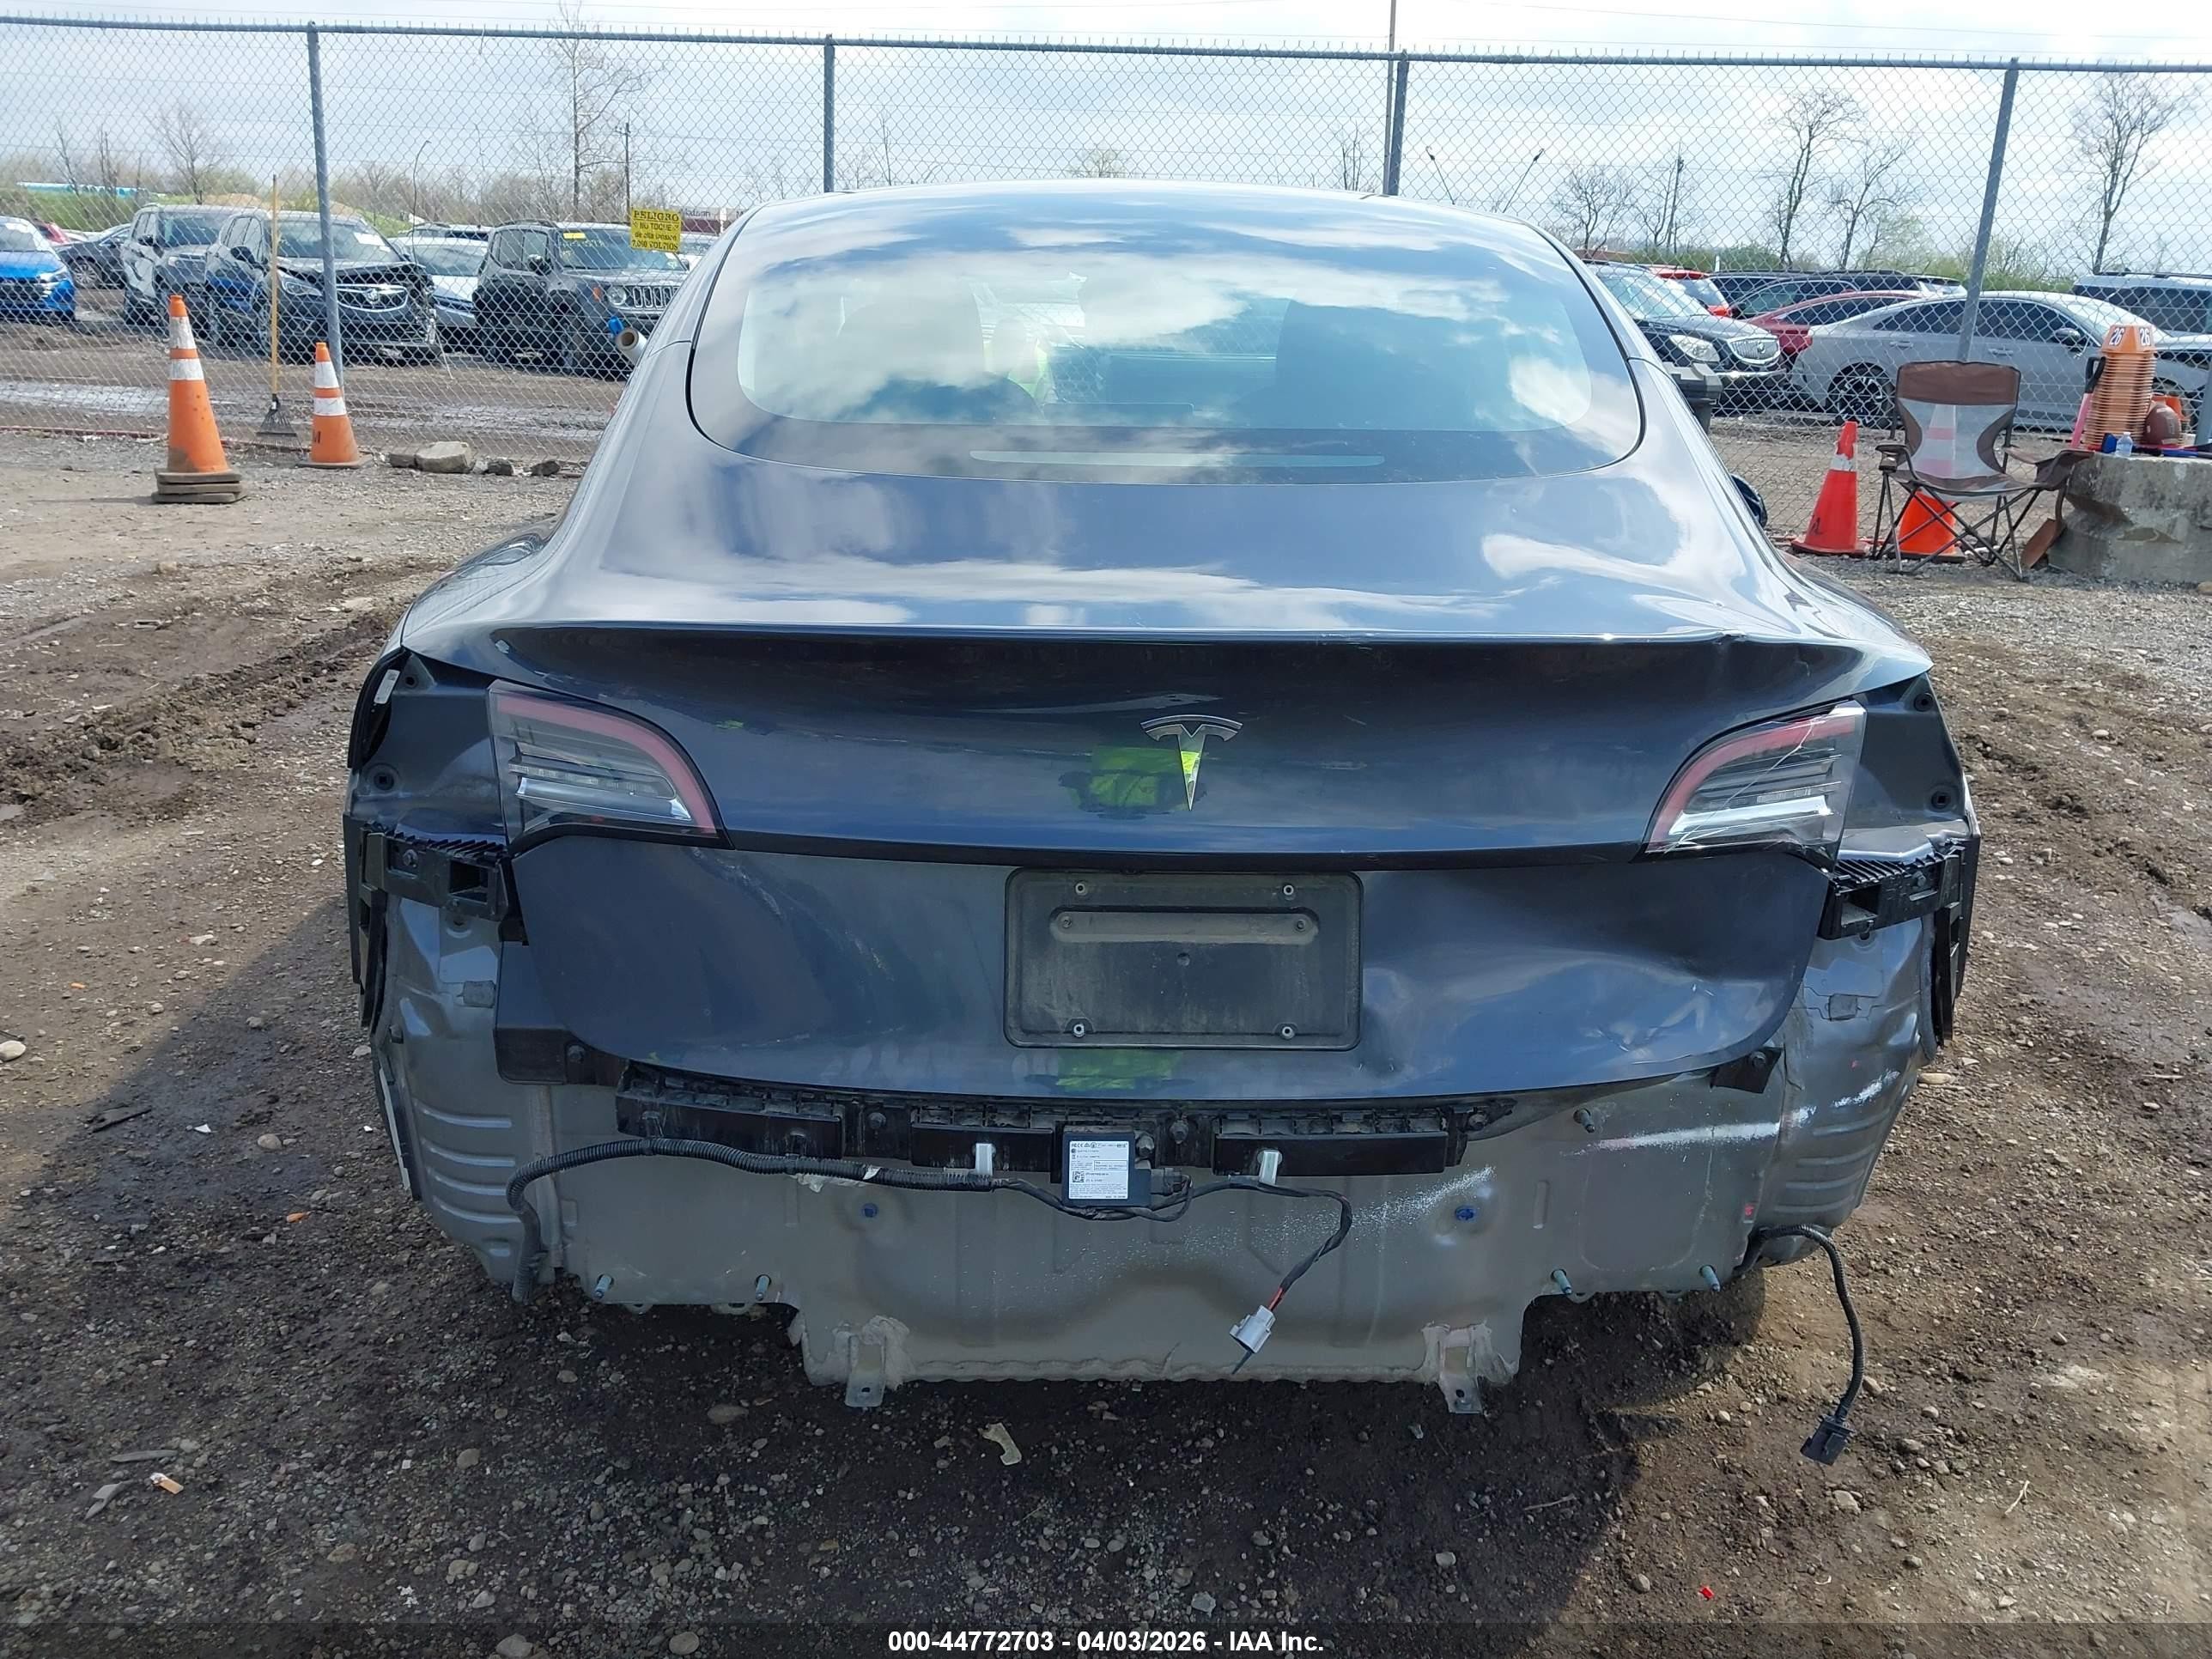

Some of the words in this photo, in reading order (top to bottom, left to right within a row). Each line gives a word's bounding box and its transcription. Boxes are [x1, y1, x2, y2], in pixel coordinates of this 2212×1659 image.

[634, 210, 679, 222] PELIGRO
[2109, 327, 2125, 345] 26
[2139, 328, 2151, 346] 26
